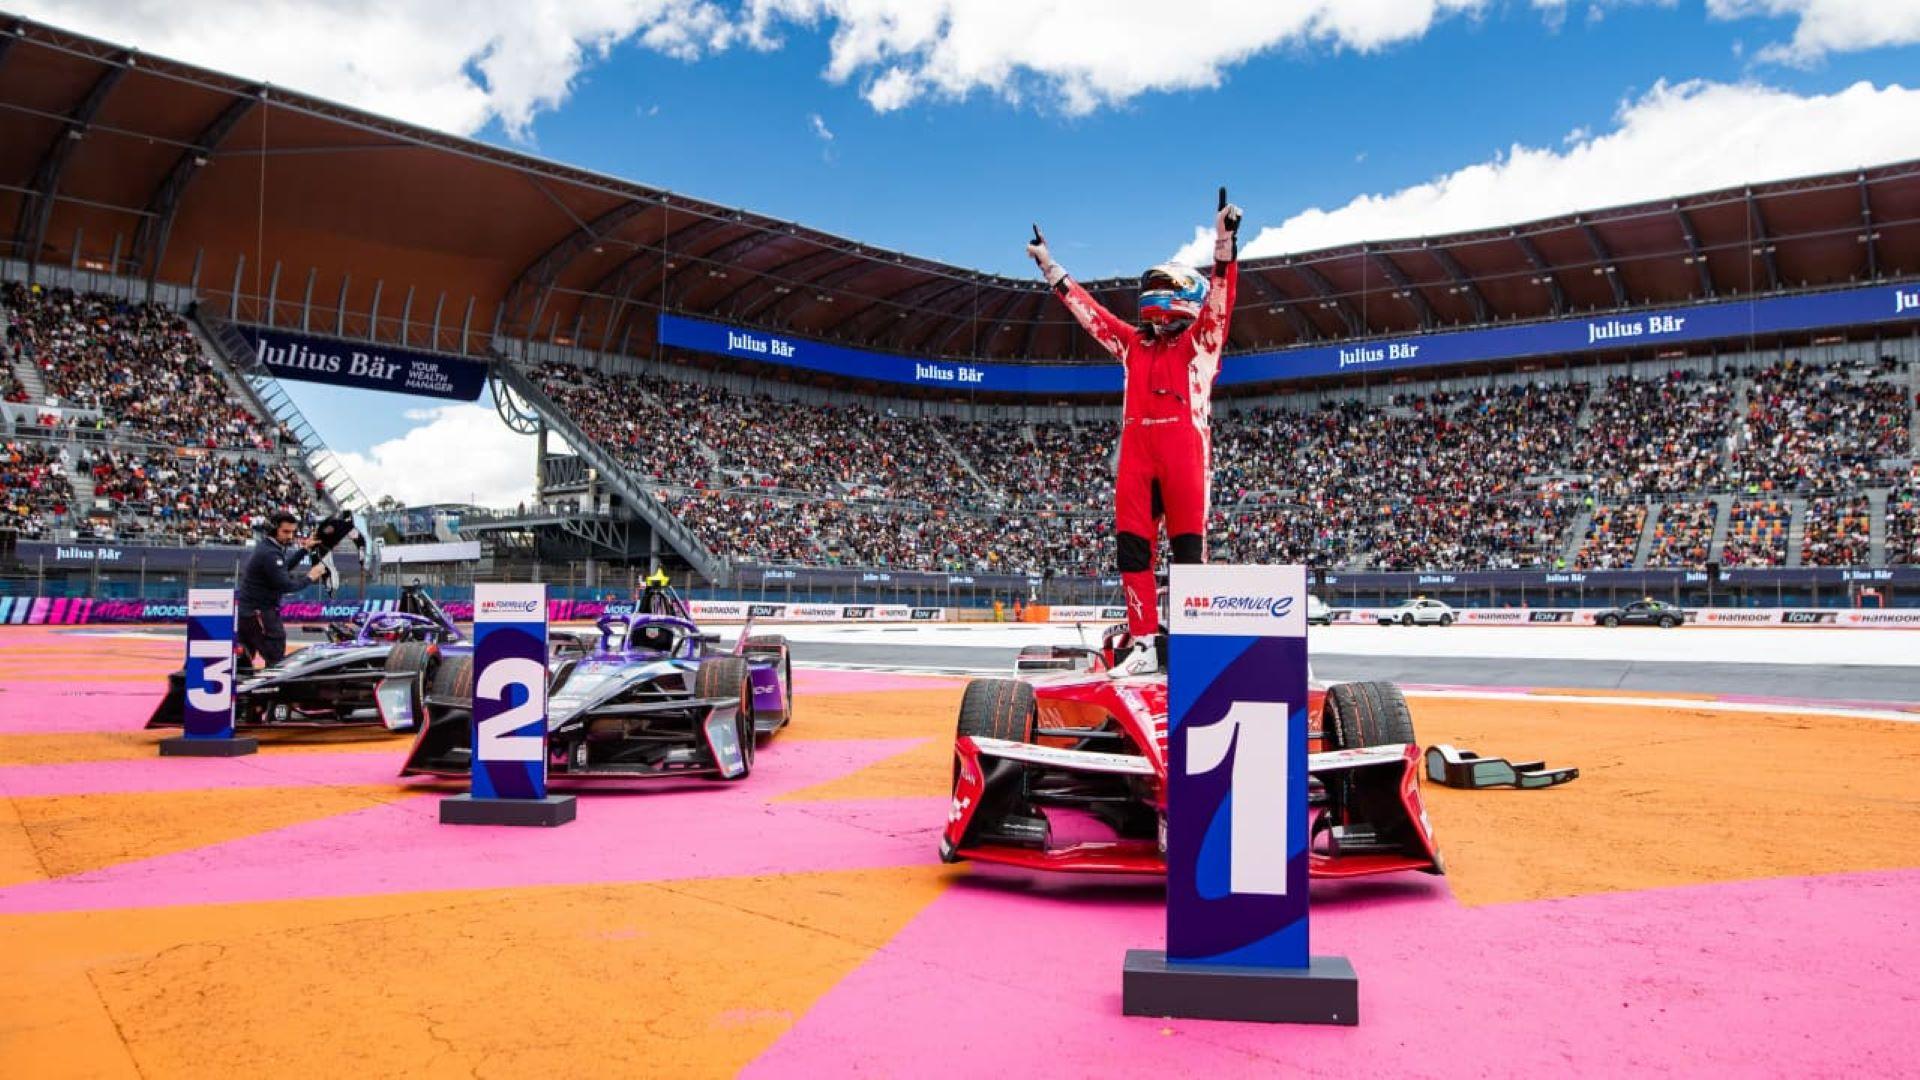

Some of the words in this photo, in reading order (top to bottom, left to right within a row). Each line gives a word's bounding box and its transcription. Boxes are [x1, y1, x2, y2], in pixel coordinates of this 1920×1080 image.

[1588, 320, 1643, 344] Julius
[1649, 315, 1686, 334] Bär
[728, 330, 767, 353] Julius
[771, 339, 796, 358] Bär
[1339, 346, 1384, 369] Julius
[1389, 342, 1420, 360] Bär
[256, 338, 341, 373] Julius
[348, 352, 402, 381] Bär
[411, 360, 439, 373] YOUR
[408, 369, 449, 383] WEALTH
[916, 362, 954, 382] Julius
[958, 367, 985, 383] Bär
[405, 379, 454, 392] MANAGER
[56, 546, 95, 562] Julius
[98, 548, 122, 561] Bär
[142, 604, 188, 617] MODE
[1184, 597, 1209, 608] ABB
[1210, 596, 1273, 610] FORMULA
[187, 640, 232, 712] 3
[476, 657, 545, 761] 2
[1186, 701, 1289, 896] 1
